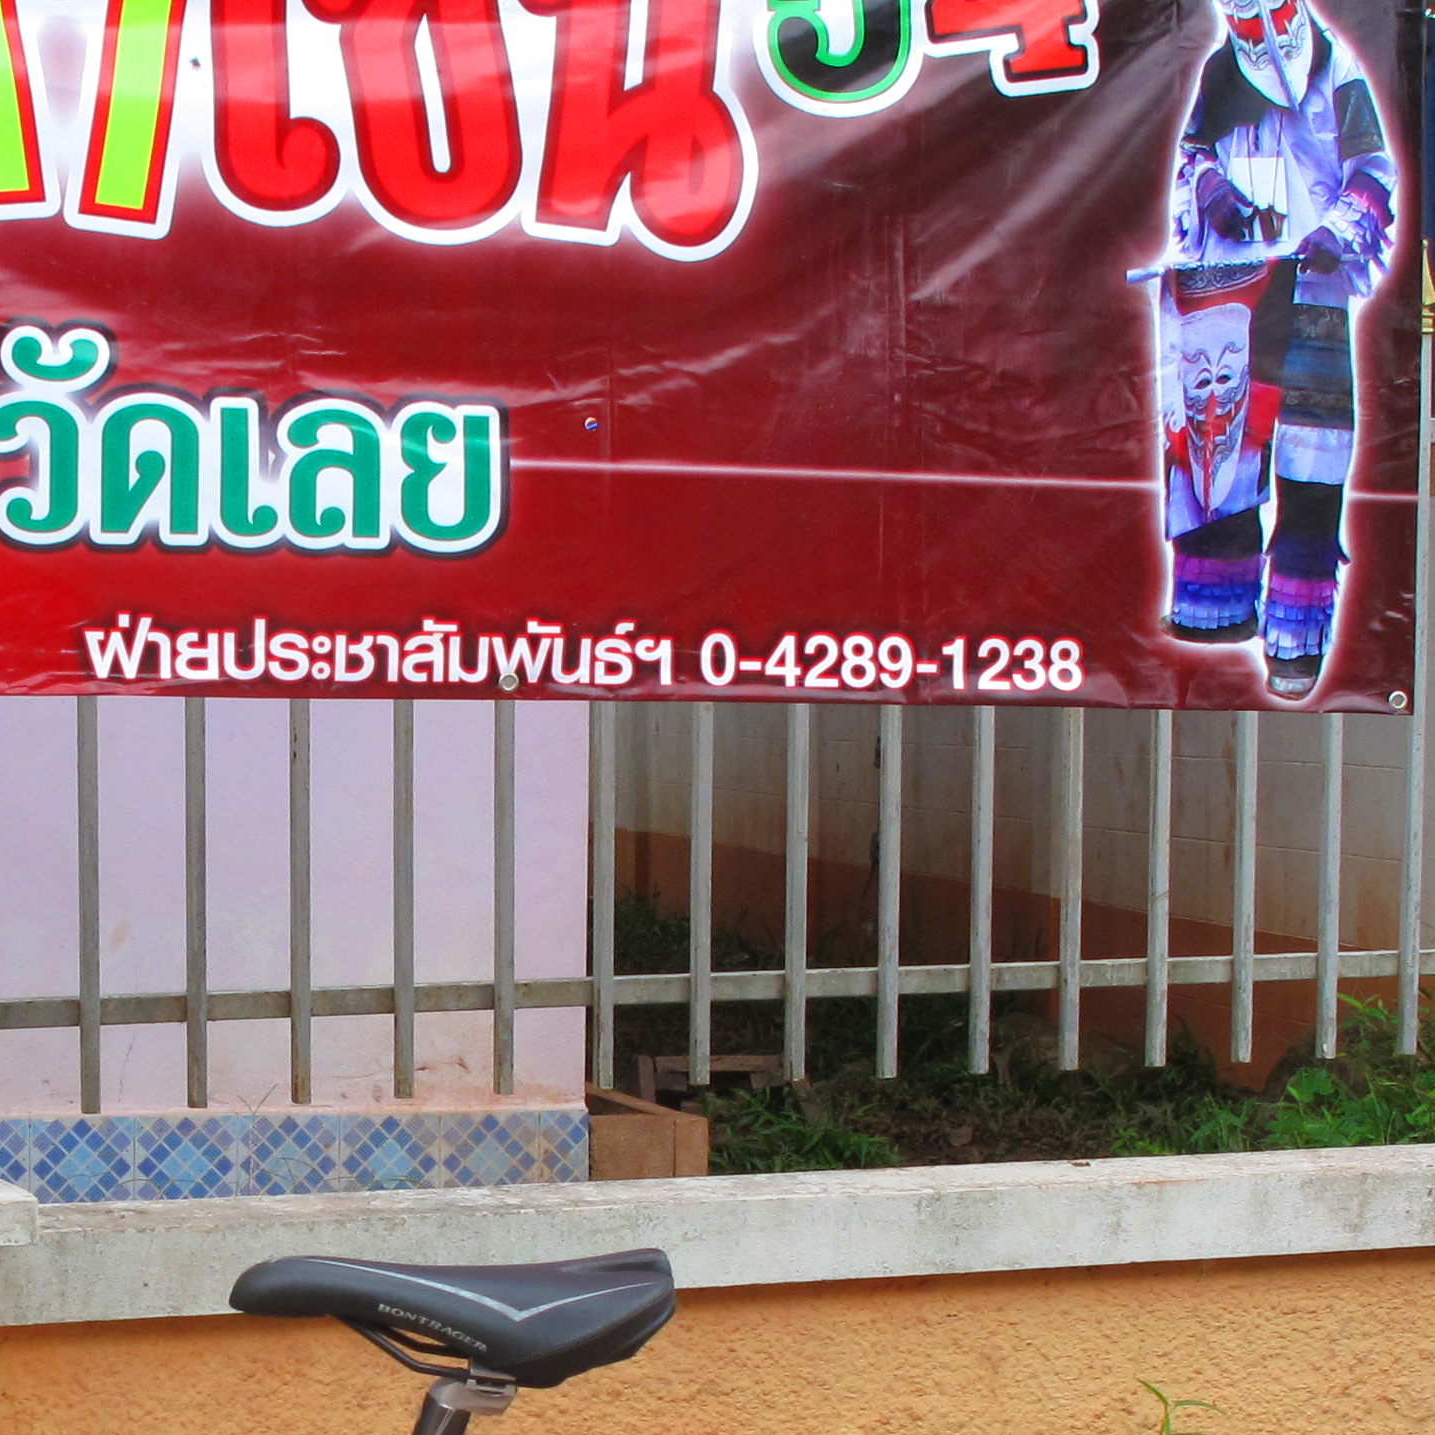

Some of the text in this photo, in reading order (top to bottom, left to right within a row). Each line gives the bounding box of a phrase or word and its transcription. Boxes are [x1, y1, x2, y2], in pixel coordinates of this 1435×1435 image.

[84, 617, 1084, 691] ฝ่ายประชาสัมพันธ์ฯ 0-4289-1238
[378, 1302, 487, 1353] BONTRAGER
